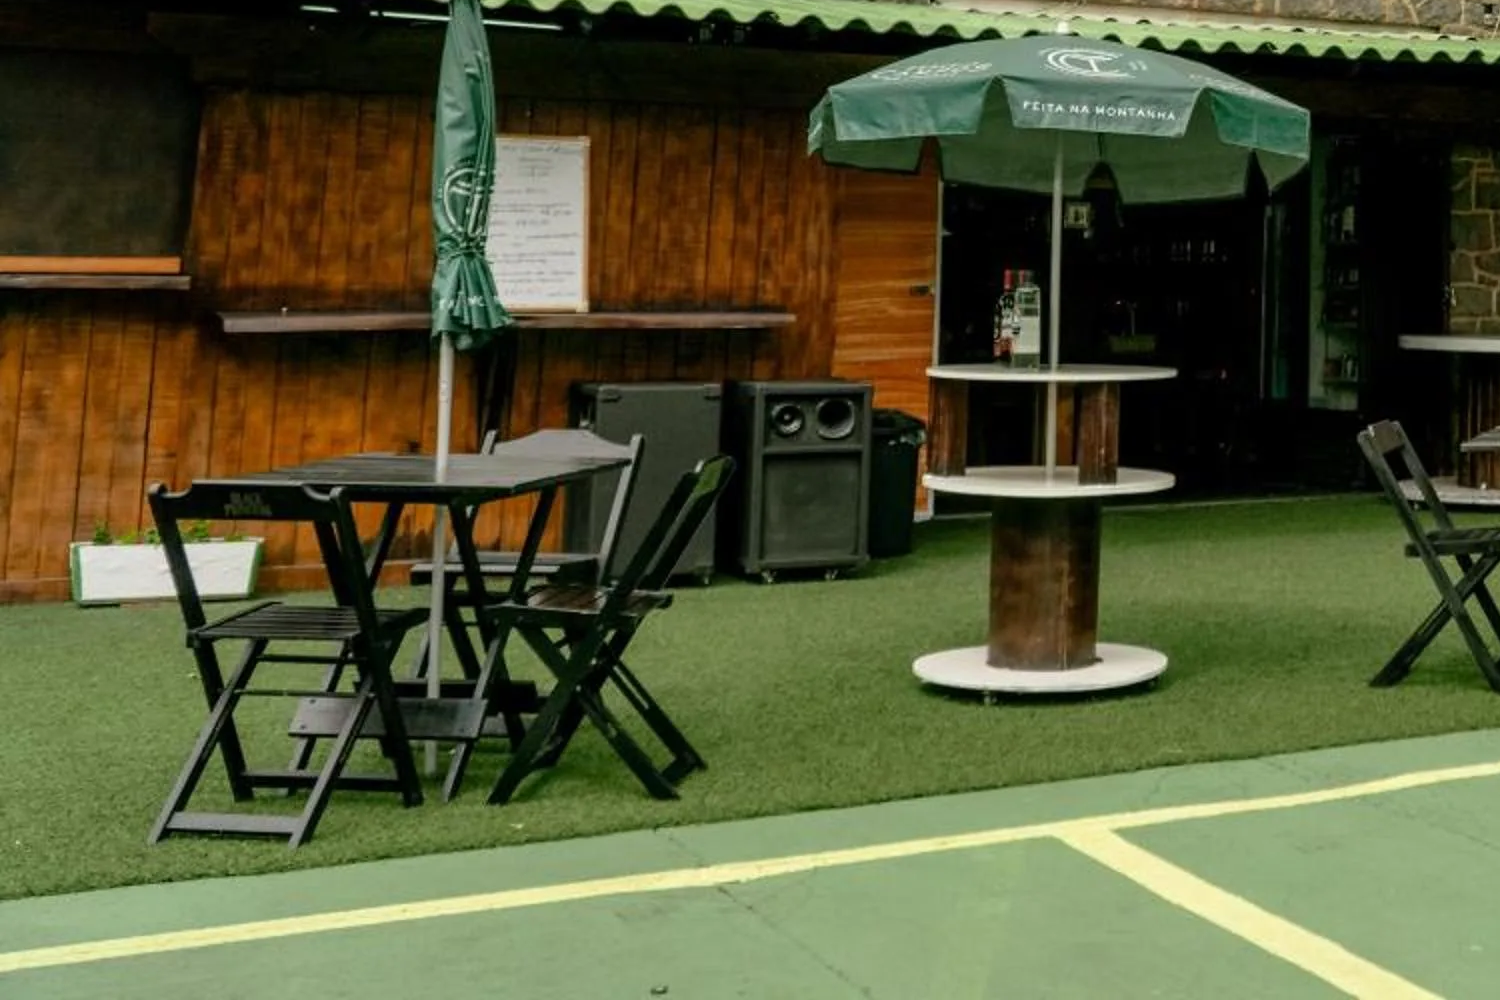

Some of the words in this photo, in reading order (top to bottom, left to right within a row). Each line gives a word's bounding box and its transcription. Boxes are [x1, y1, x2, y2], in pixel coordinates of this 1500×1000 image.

[1023, 100, 1064, 113] FEITA
[1069, 104, 1090, 115] NA
[1095, 105, 1176, 121] MONTANHA
